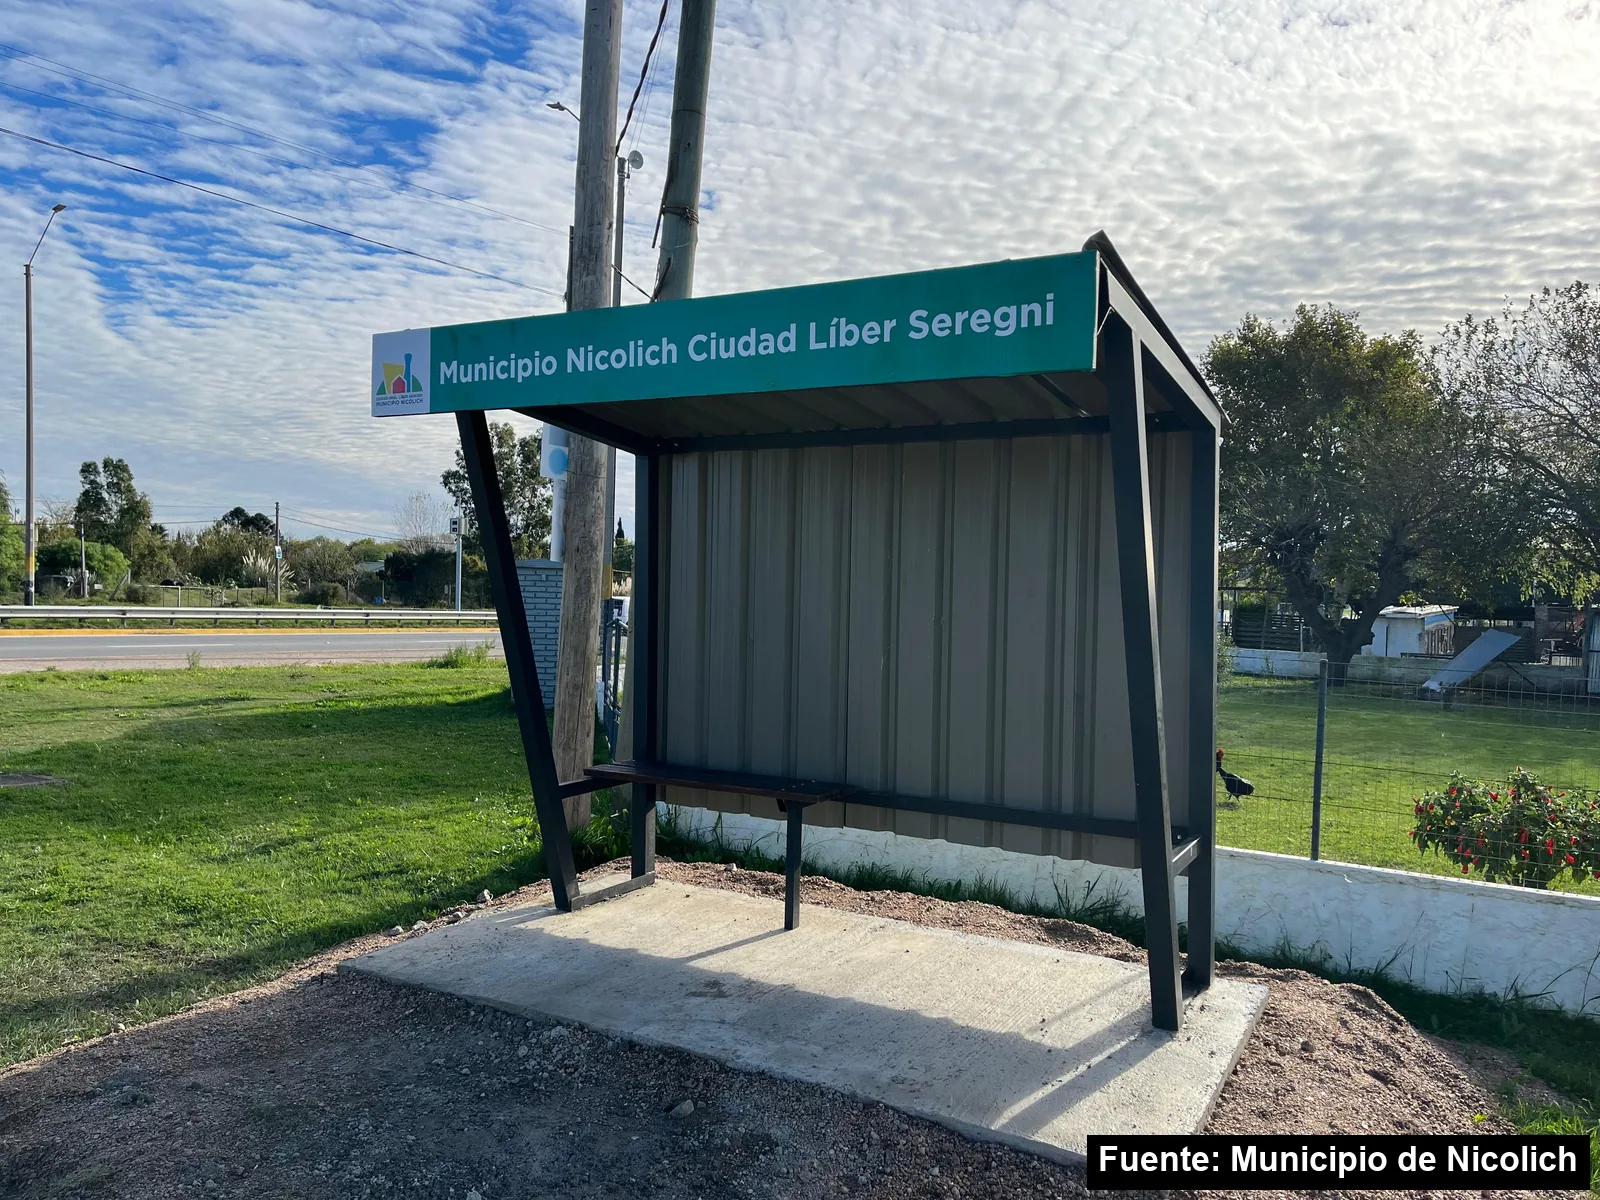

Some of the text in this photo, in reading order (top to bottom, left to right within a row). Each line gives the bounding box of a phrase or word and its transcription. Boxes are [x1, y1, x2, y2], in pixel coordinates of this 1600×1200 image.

[439, 292, 1055, 385] Municipio Nicolich Ciudad Líber Seregni
